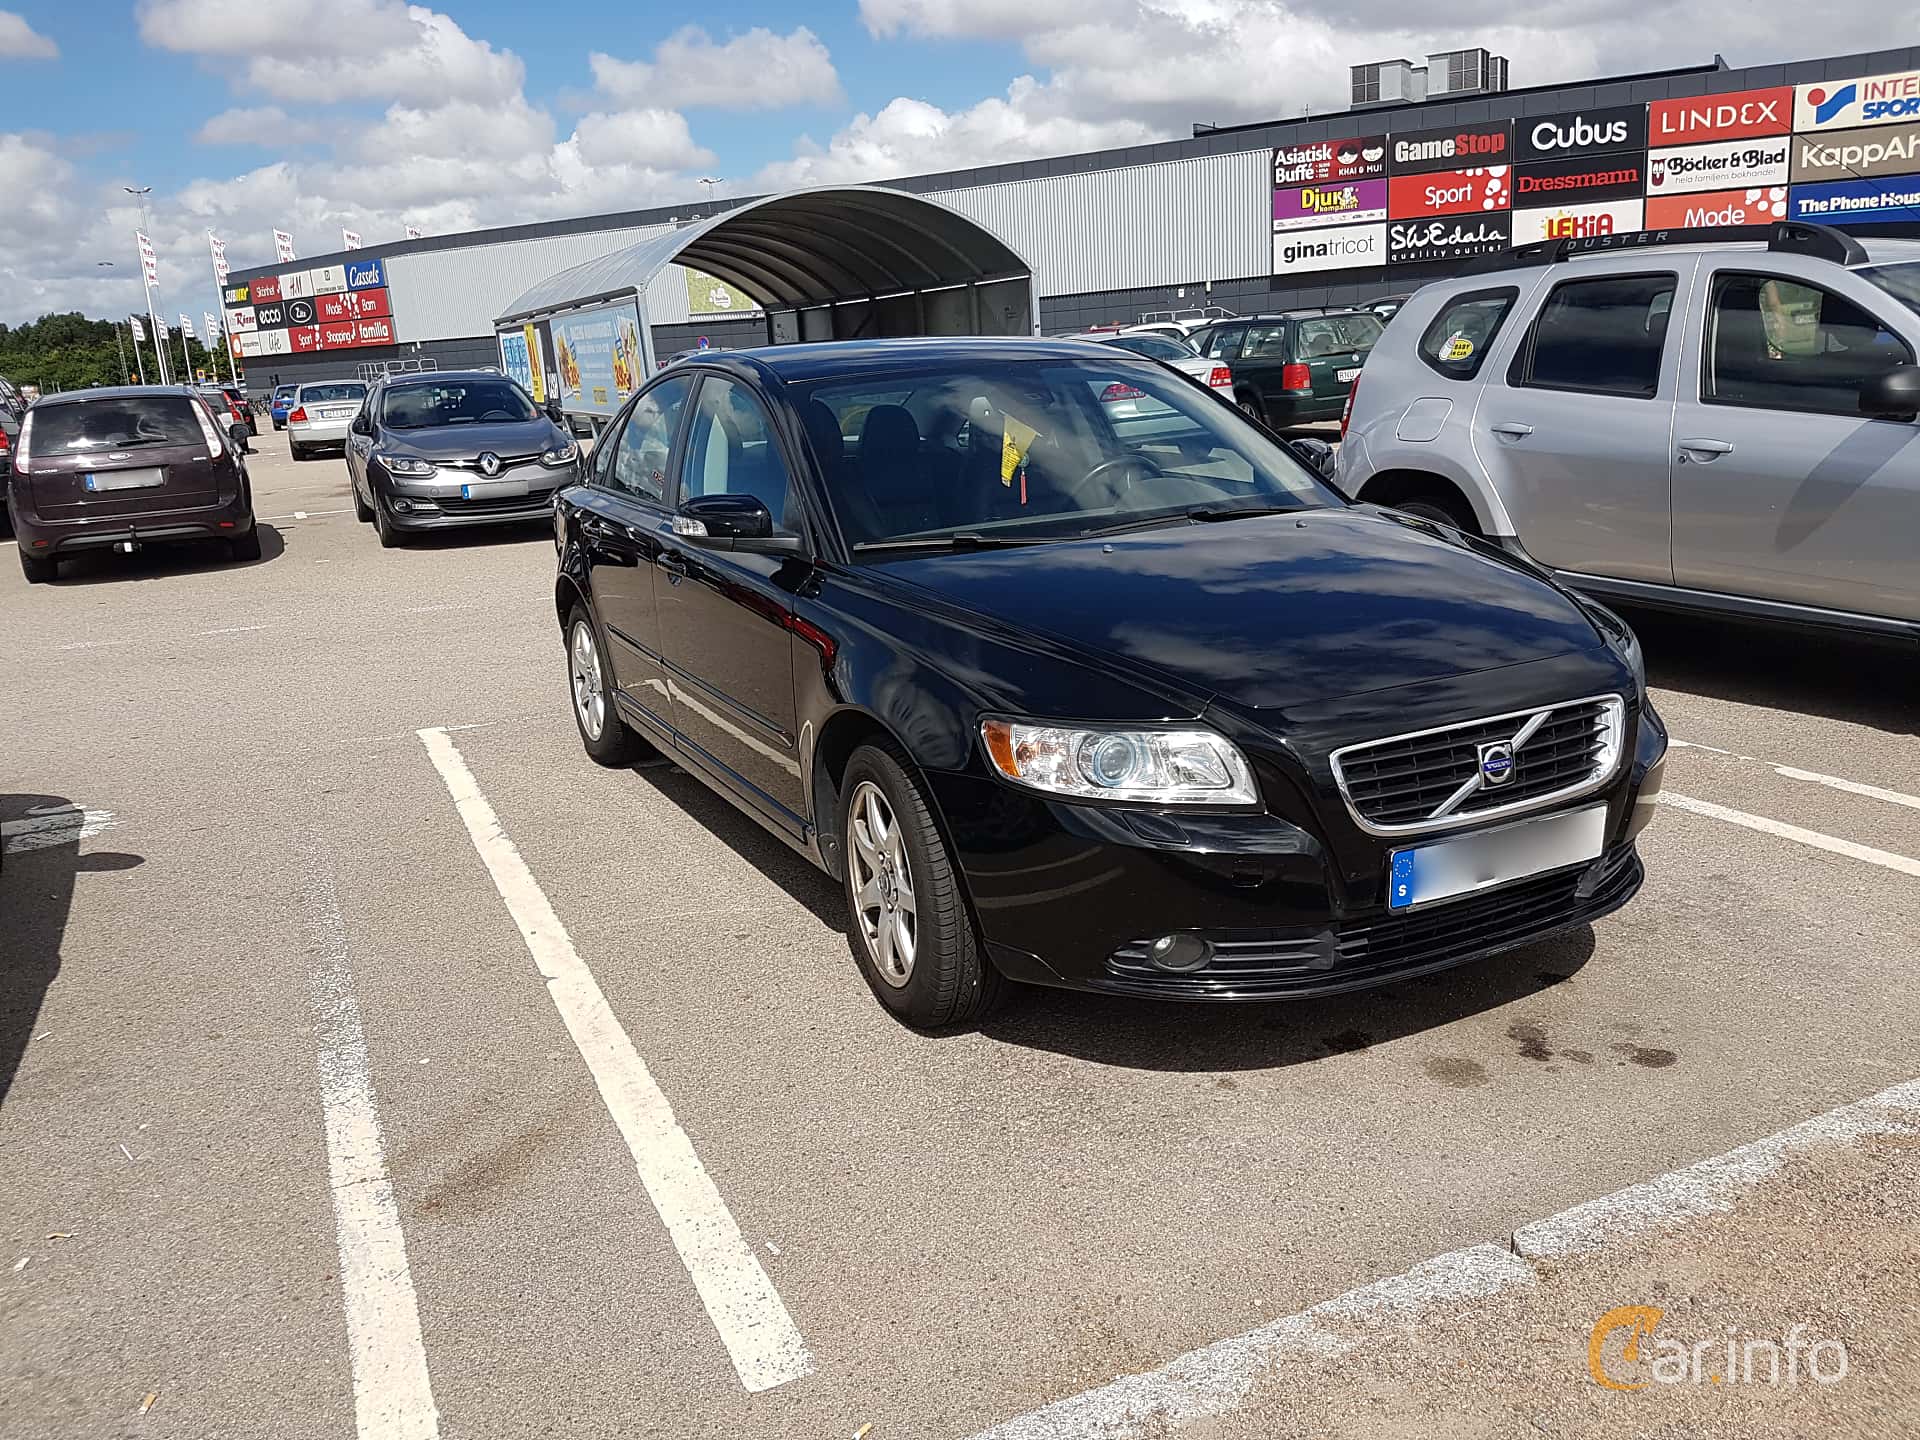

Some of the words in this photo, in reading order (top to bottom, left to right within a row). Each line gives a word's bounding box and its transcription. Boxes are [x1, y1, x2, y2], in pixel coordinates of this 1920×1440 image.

[1863, 77, 1920, 101] INTE
[1661, 100, 1778, 133] LINDEX
[1862, 97, 1920, 120] SPOR
[1531, 116, 1628, 150] Cubus
[1274, 143, 1332, 166] Asiatisk
[1395, 133, 1505, 162] GameStop
[1801, 134, 1920, 170] KappAh
[1339, 167, 1357, 176] KHAI
[1667, 155, 1728, 175] Böcker
[1730, 152, 1741, 168] &
[1742, 148, 1785, 168] Blad
[1275, 163, 1314, 184] Buffé
[1518, 168, 1639, 193] Dressmann
[1424, 183, 1472, 209] Sport
[1798, 199, 1829, 213] The
[1830, 196, 1880, 211] Phone
[1880, 192, 1920, 207] Hous
[1684, 203, 1745, 228] Mode
[1567, 231, 1668, 250] DUSTER
[1392, 248, 1446, 261] quality
[1455, 244, 1501, 255] outlet
[349, 263, 379, 287] Cassels
[325, 302, 343, 316] Mode
[298, 333, 313, 348] Sport
[326, 328, 352, 344] Shopping
[1398, 884, 1407, 897] S
